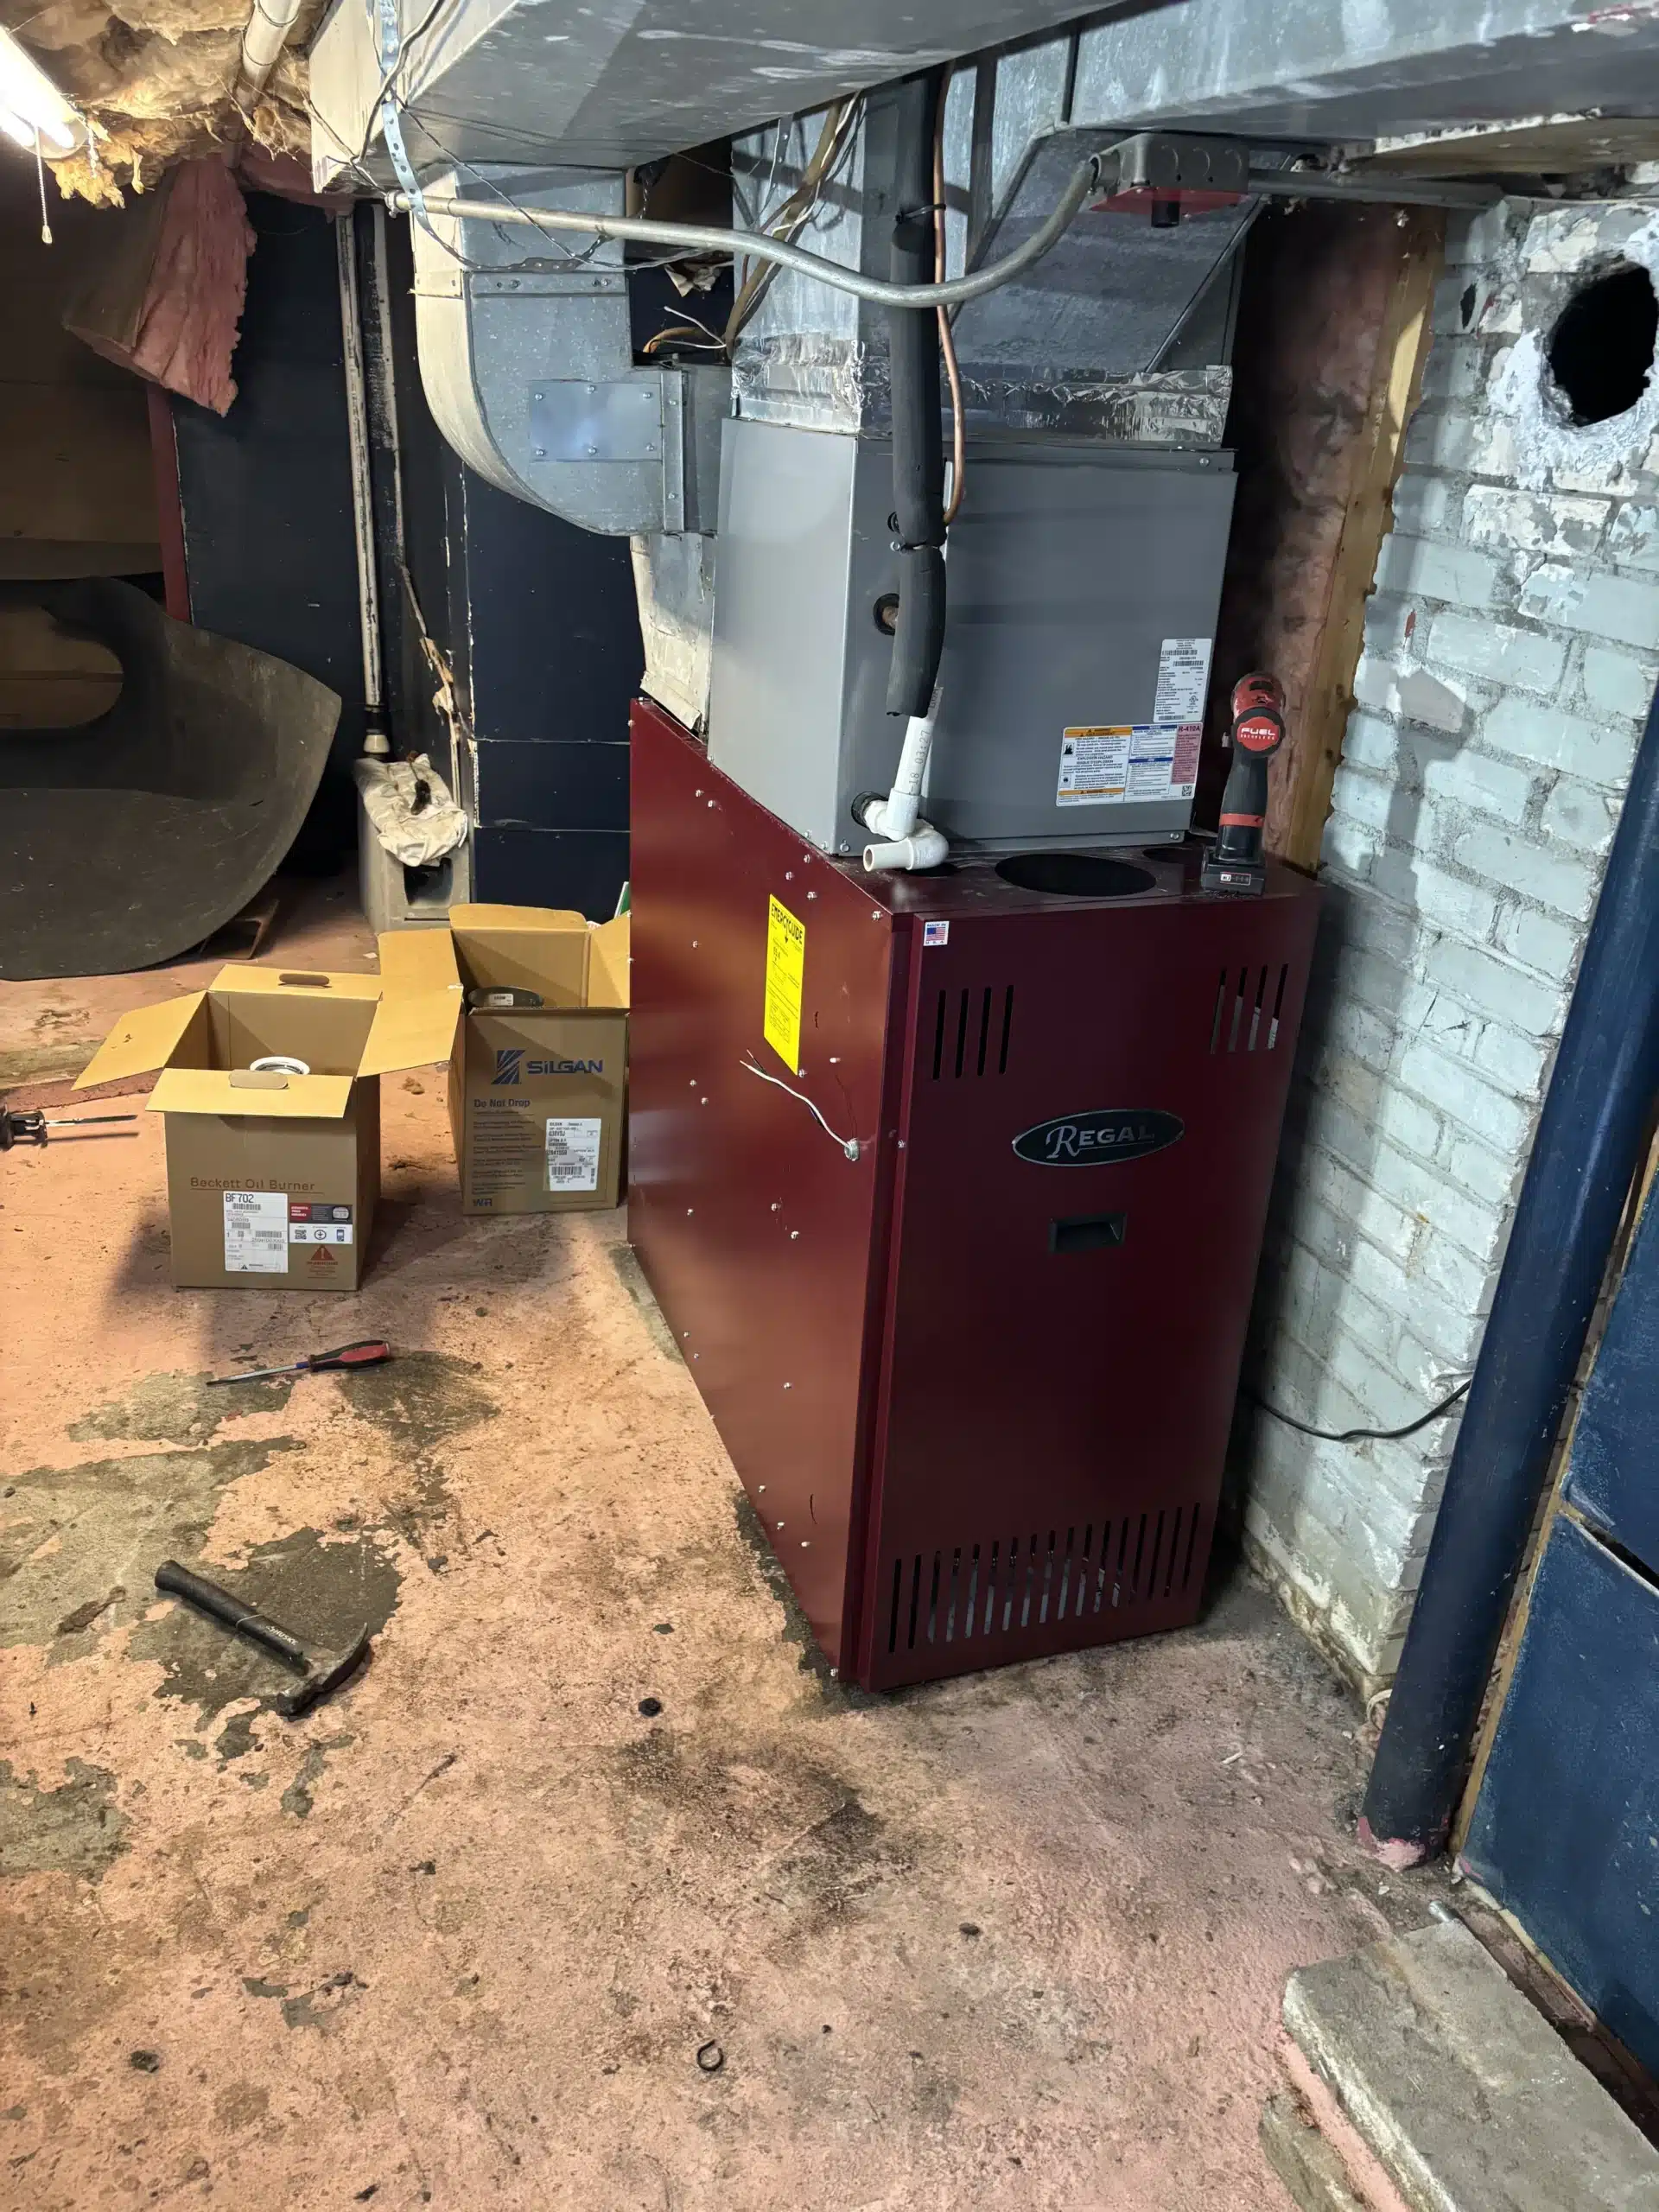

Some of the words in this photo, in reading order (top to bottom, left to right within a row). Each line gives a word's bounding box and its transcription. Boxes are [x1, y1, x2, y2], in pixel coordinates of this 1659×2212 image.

[1241, 727, 1276, 736] FUEL
[914, 729, 931, 764] 03:27
[474, 1099, 486, 1108] Do
[490, 1098, 505, 1108] Not
[508, 1098, 531, 1109] Drop
[1045, 1125, 1155, 1159] REGAL
[190, 1177, 241, 1189] Beckett
[245, 1179, 264, 1189] Oil
[270, 1179, 315, 1191] Burner
[226, 1193, 254, 1203] BF702
[272, 1629, 299, 1646] HUSKY
